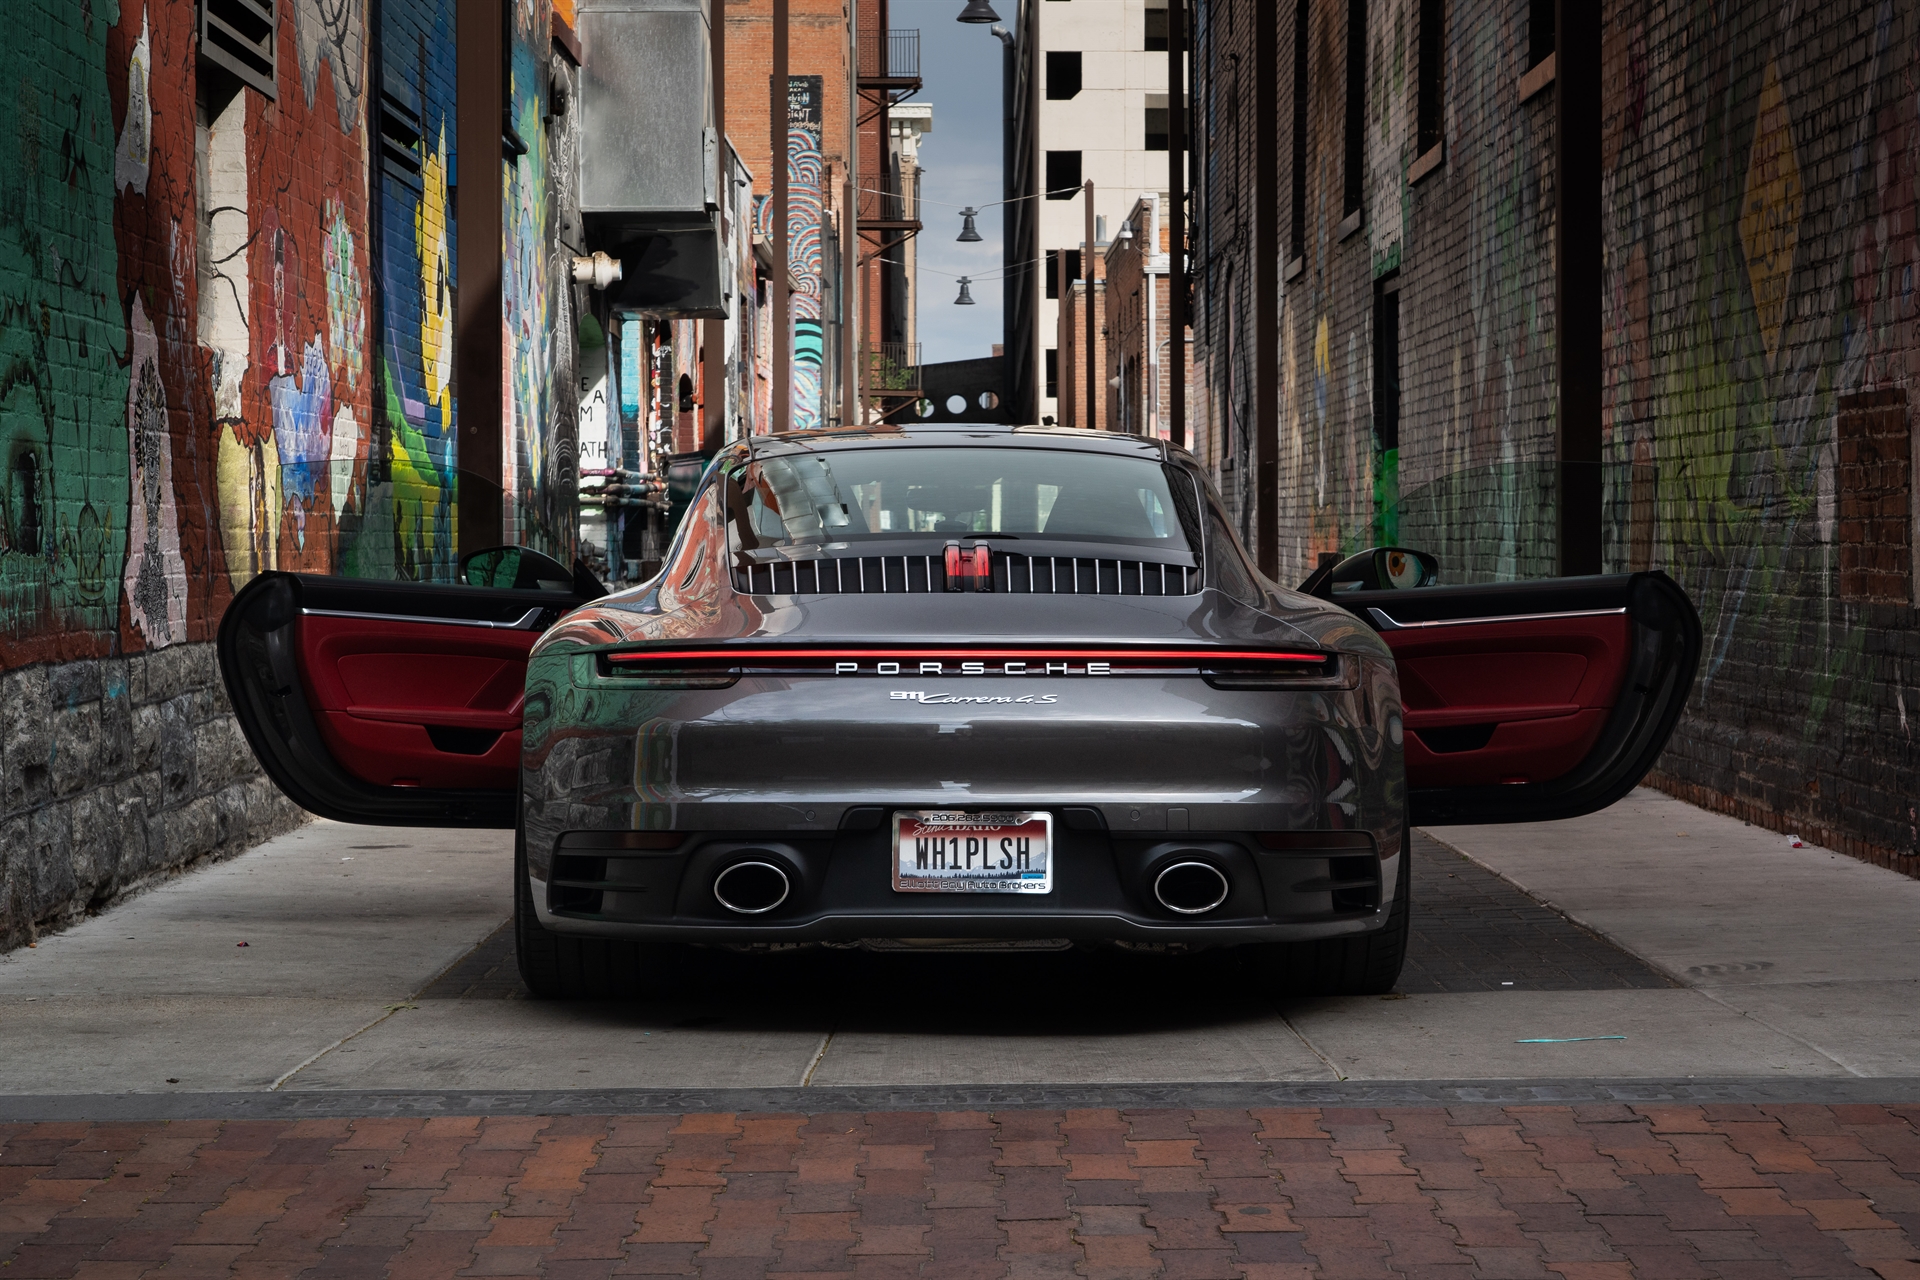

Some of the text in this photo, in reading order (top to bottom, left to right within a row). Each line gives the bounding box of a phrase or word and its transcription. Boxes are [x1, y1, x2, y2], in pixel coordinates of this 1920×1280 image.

[835, 662, 1111, 675] PORSCHE
[889, 691, 925, 701] 911
[919, 692, 1014, 705] Carrera
[915, 837, 1030, 870] WH1PLSH
[940, 880, 966, 892] Bay
[967, 880, 998, 890] Auto
[998, 881, 1046, 890] Brokers
